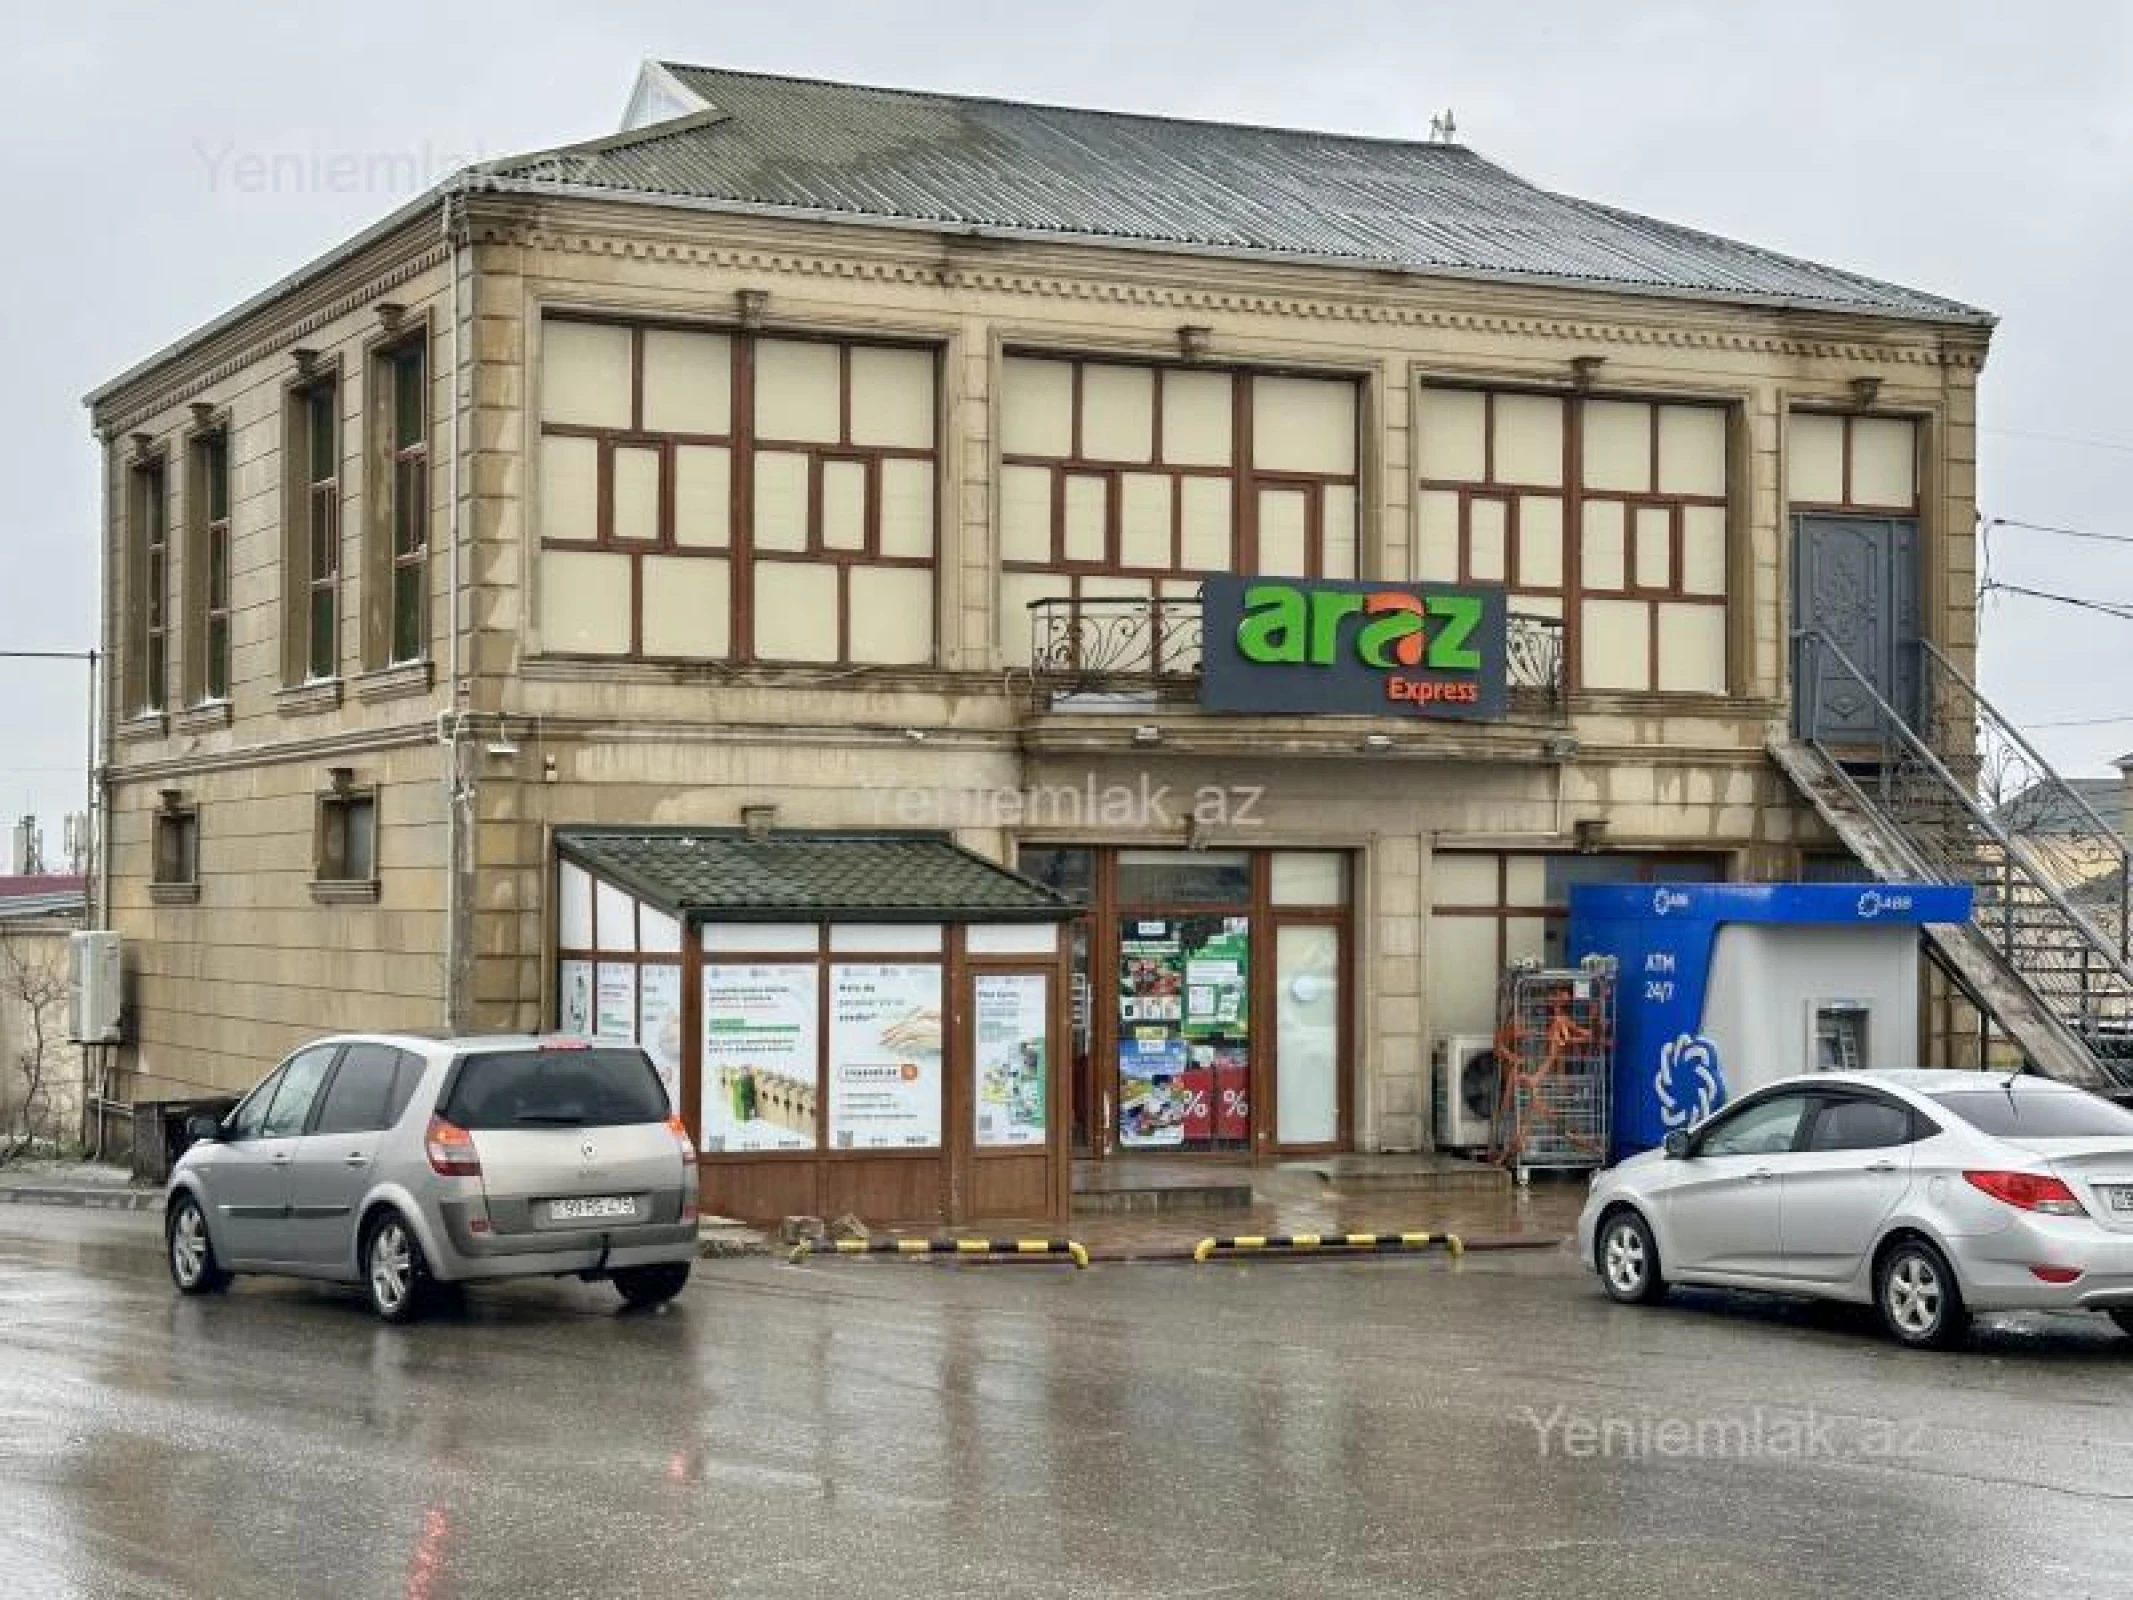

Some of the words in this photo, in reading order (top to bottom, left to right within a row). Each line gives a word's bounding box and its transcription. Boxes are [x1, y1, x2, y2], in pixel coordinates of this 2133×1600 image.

[1237, 586, 1483, 669] araz
[1387, 677, 1478, 705] Express
[1645, 953, 1675, 972] ATM
[1645, 981, 1674, 1003] 24/7
